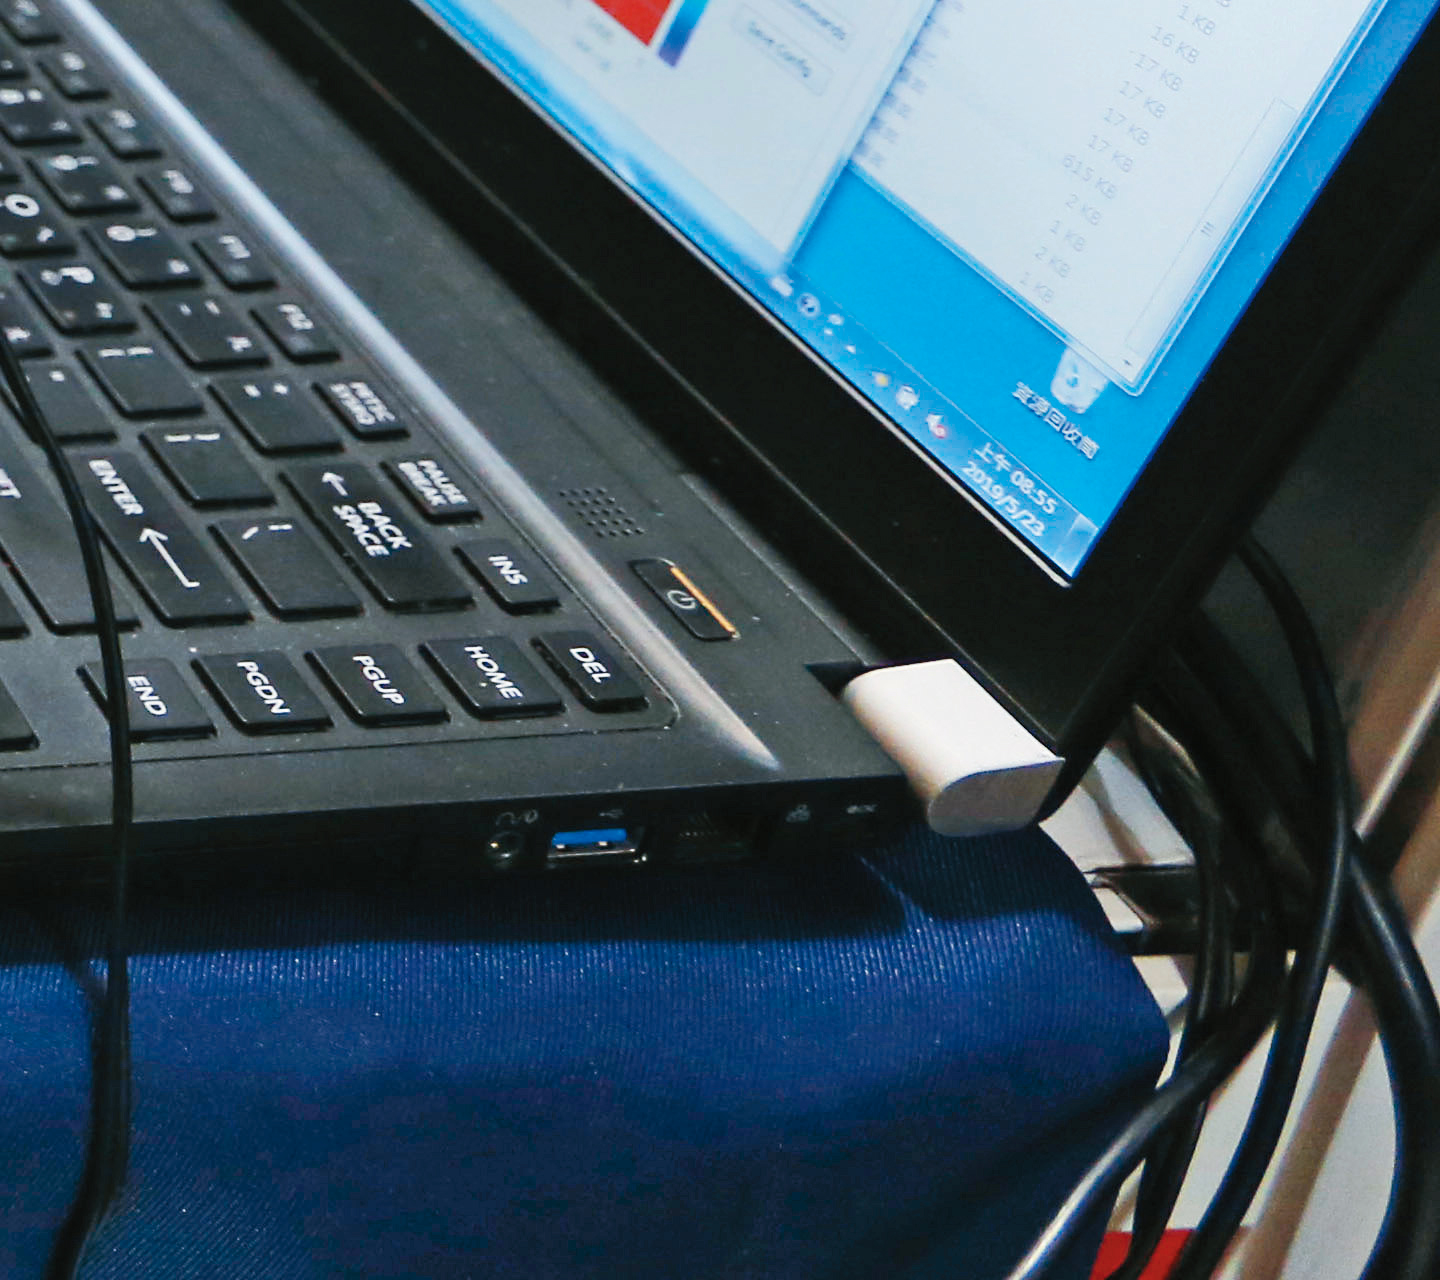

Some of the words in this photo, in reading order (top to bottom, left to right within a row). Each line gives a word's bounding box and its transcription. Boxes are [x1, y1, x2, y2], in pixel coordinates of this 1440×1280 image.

[1177, 4, 1189, 21] 1
[1191, 13, 1216, 36] KB
[1150, 25, 1176, 48] 16
[1175, 41, 1200, 64] KB
[1135, 53, 1161, 72] 17
[1160, 68, 1183, 92] KB
[1119, 80, 1144, 100] 17
[1144, 96, 1167, 119] KB
[1104, 107, 1128, 127] 17
[1127, 123, 1150, 146] KB
[1088, 134, 1112, 153] 17
[1112, 150, 1134, 173] KB
[1062, 154, 1095, 182] 615
[1095, 176, 1117, 200] KB
[4, 193, 41, 218] O
[1065, 193, 1079, 209] 2
[1081, 203, 1102, 226] KB
[1049, 219, 1061, 235] 1
[1064, 229, 1086, 253] KB
[58, 266, 96, 285] P
[1034, 246, 1048, 261] 2
[1048, 255, 1071, 279] KB
[1019, 271, 1031, 286] 1
[1033, 281, 1055, 304] KB
[1011, 380, 1100, 460] 資源回收筒
[88, 458, 145, 516] ENTER
[397, 461, 448, 507] BREAK
[417, 459, 469, 505] PAUSE
[974, 441, 1012, 472] 上午
[1009, 470, 1059, 514] 08:55
[961, 460, 1046, 537] 2019/5/23
[332, 504, 391, 558] SPACE
[357, 501, 413, 549] BACK
[487, 555, 529, 586] INS
[352, 654, 406, 706] PGUP
[463, 644, 524, 700] HOME
[568, 646, 609, 685] DEL
[126, 673, 169, 718] END
[236, 660, 292, 715] PGDN
